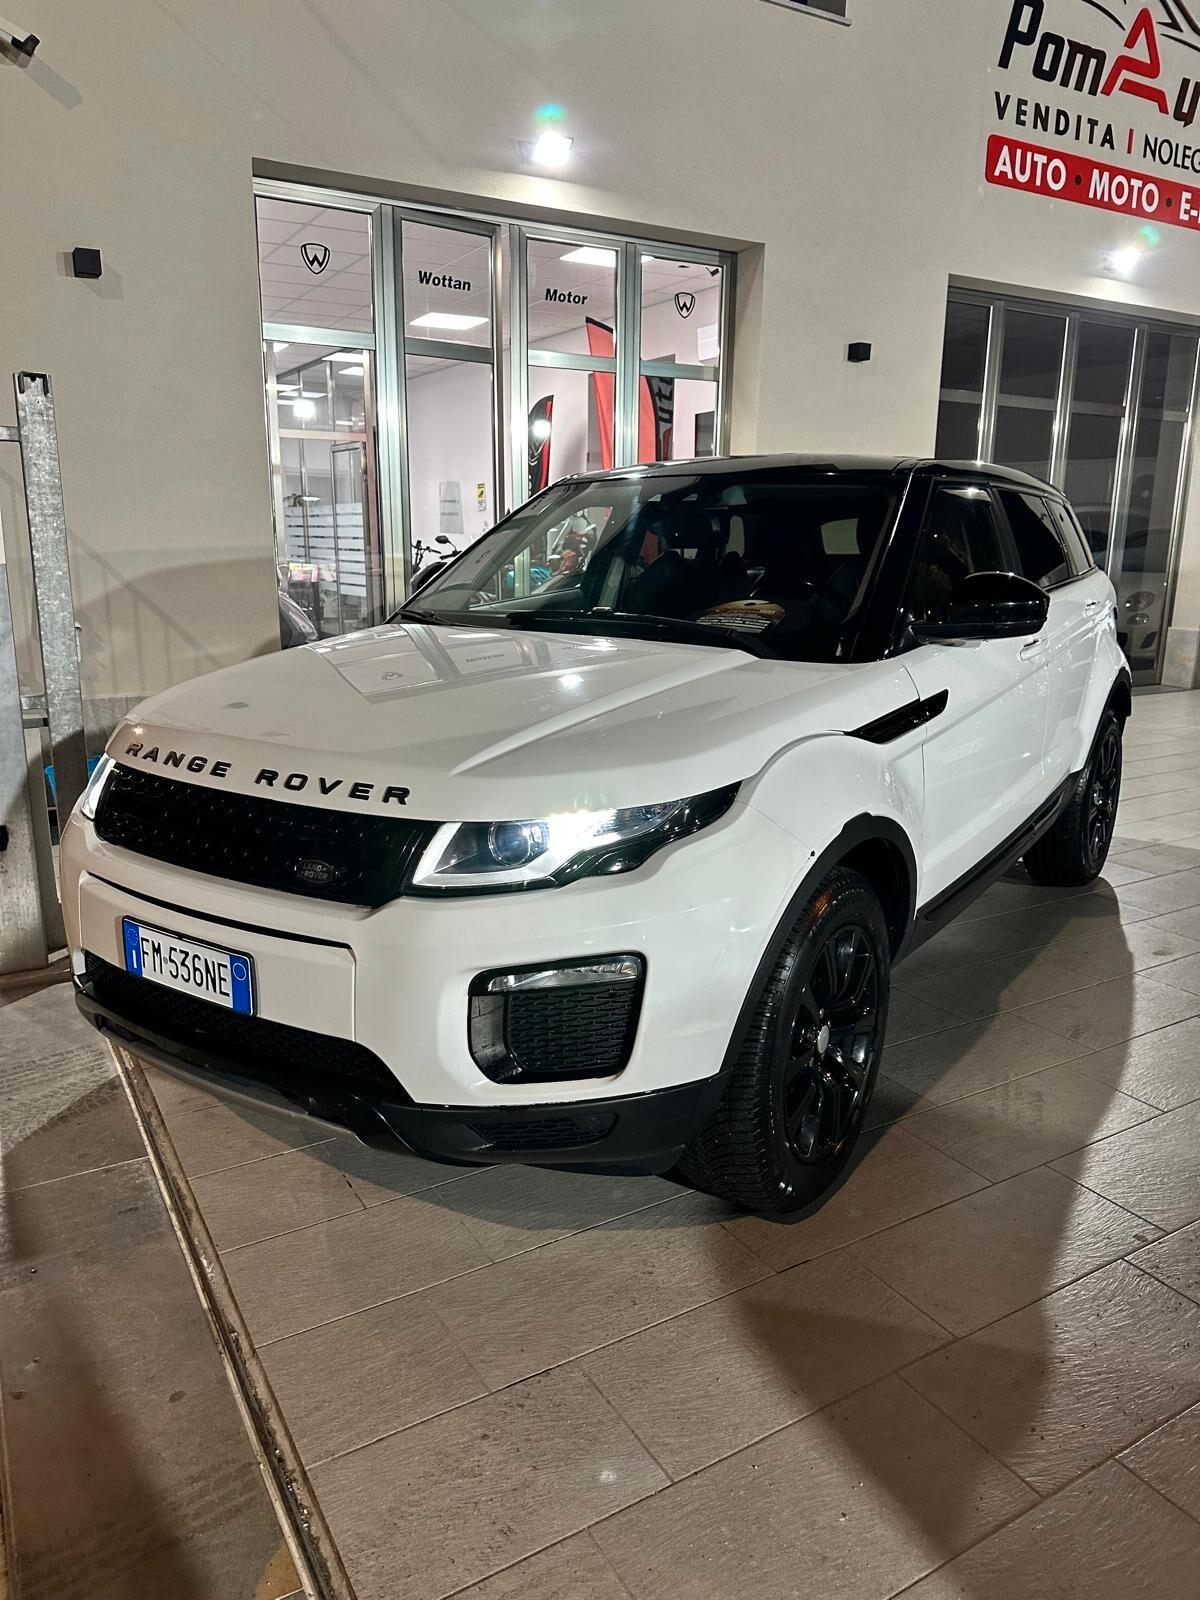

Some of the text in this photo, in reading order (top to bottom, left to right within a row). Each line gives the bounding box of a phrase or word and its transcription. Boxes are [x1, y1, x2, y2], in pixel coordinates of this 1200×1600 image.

[994, 91, 1115, 150] VENDITA
[993, 145, 1067, 191] AUTO
[1088, 168, 1160, 213] MOTO
[417, 270, 472, 292] Wottan
[544, 287, 588, 306] Motor
[125, 742, 411, 806] RANGE ROVER
